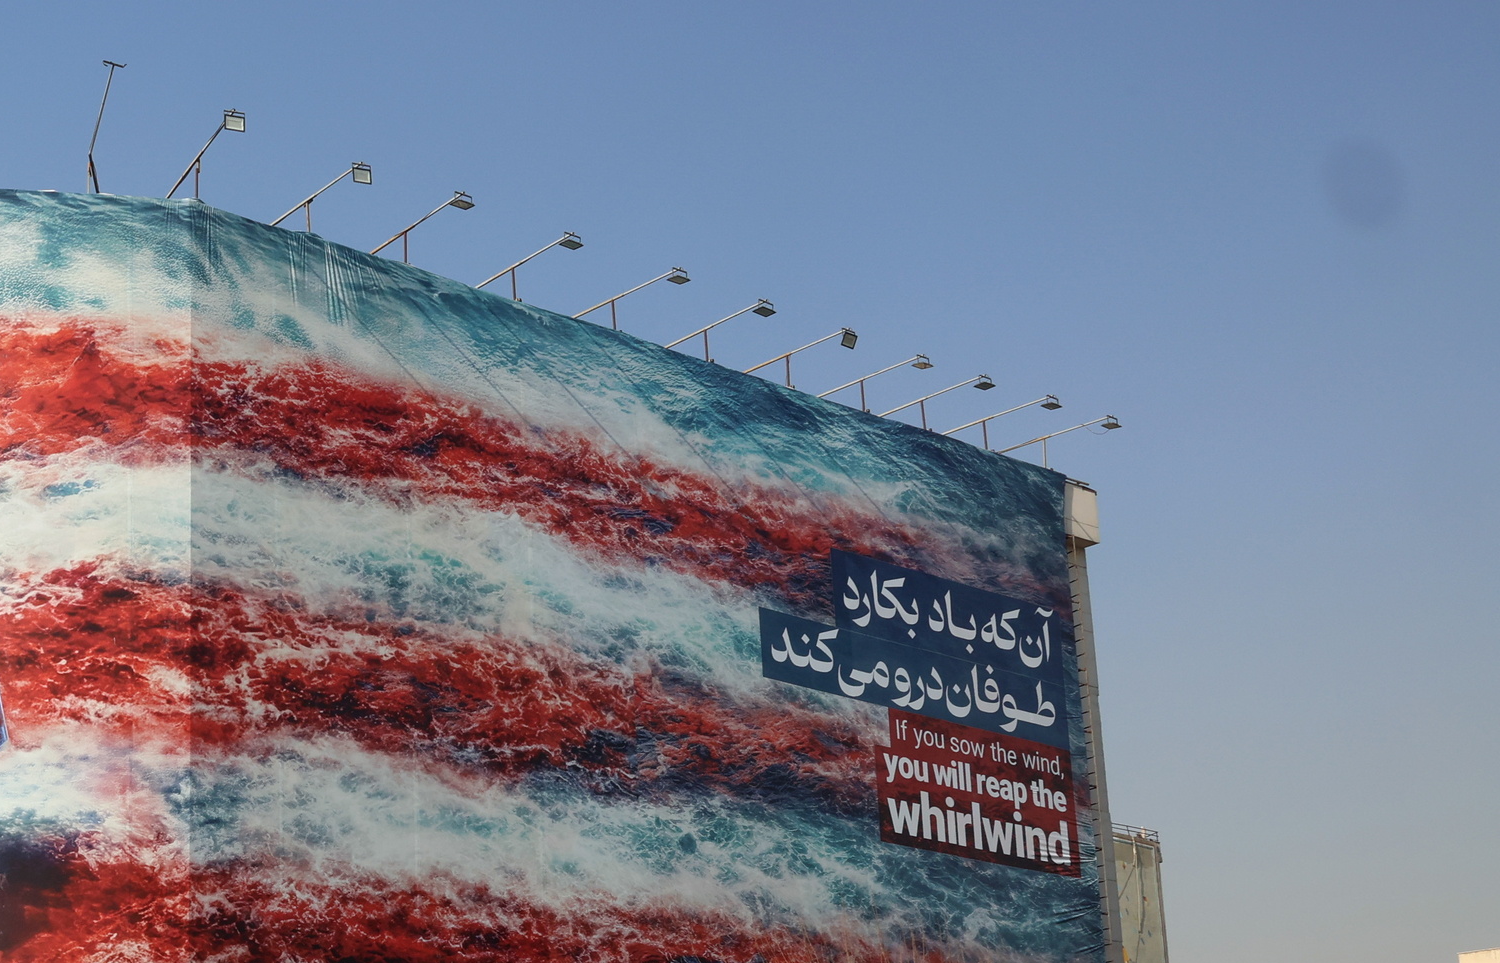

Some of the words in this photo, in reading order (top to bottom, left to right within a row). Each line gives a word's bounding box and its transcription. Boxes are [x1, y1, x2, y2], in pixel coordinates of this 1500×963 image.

[843, 570, 919, 639] بکارد
[928, 590, 977, 654] باد
[896, 719, 907, 741] If
[913, 727, 945, 749] you
[950, 736, 985, 758] sow
[990, 742, 1017, 765] the
[1022, 751, 1065, 780] wind,
[883, 752, 929, 783] you
[932, 760, 972, 792] will
[976, 773, 1027, 809] reap
[1030, 779, 1067, 812] the
[887, 790, 1072, 866] whirlwind
